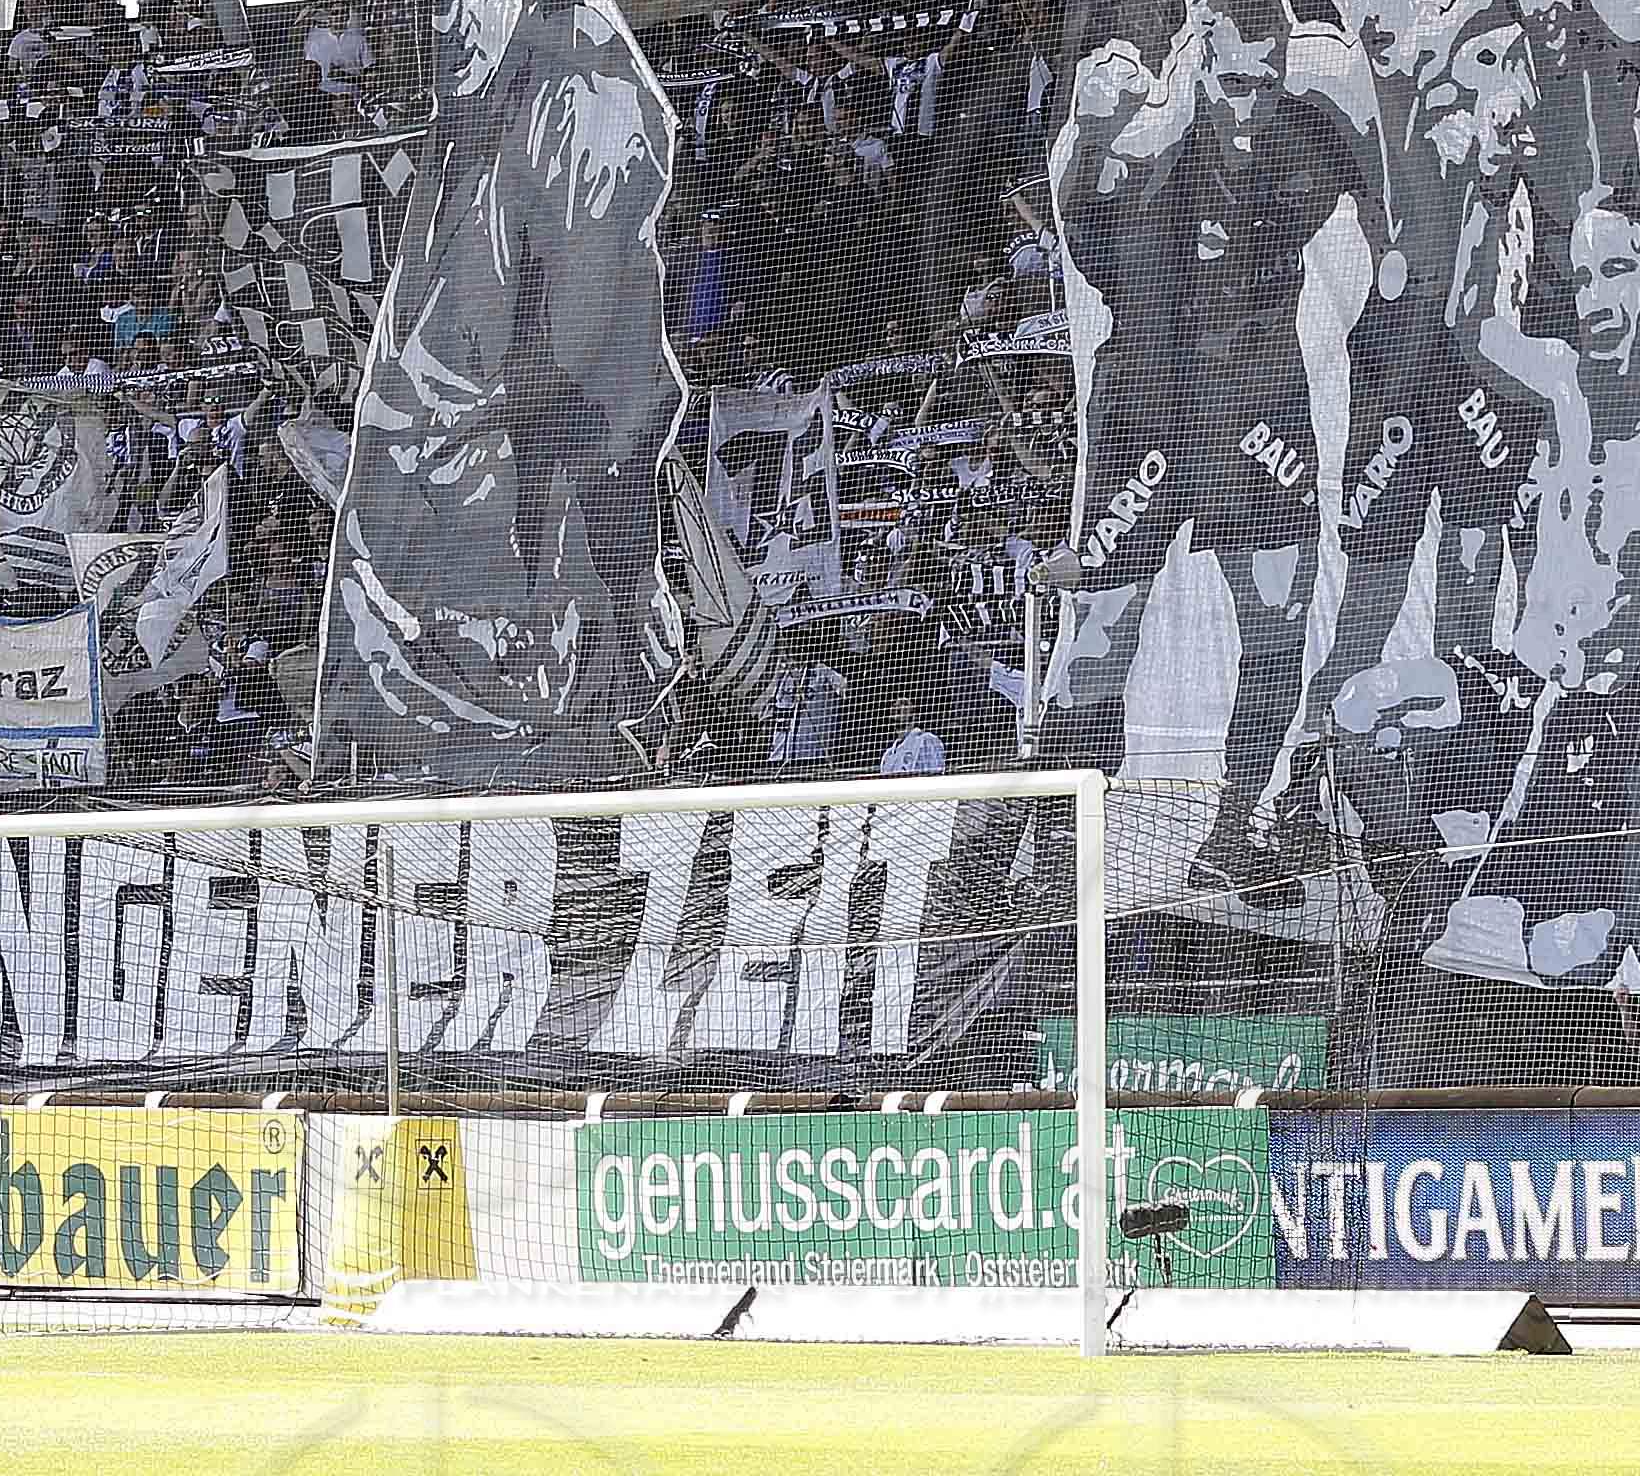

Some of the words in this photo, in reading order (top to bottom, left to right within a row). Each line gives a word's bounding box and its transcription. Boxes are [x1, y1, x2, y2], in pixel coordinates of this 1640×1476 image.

[1240, 421, 1304, 488] BAU
[1458, 388, 1510, 469] BAU
[1080, 450, 1167, 568] VARIO
[587, 800, 959, 1057] ZEIT
[592, 1122, 1136, 1259] genusscard.at
[641, 1253, 795, 1286] Thermenland
[805, 1251, 939, 1286] Steiermark
[966, 1250, 1140, 1288] Oststeierrk
